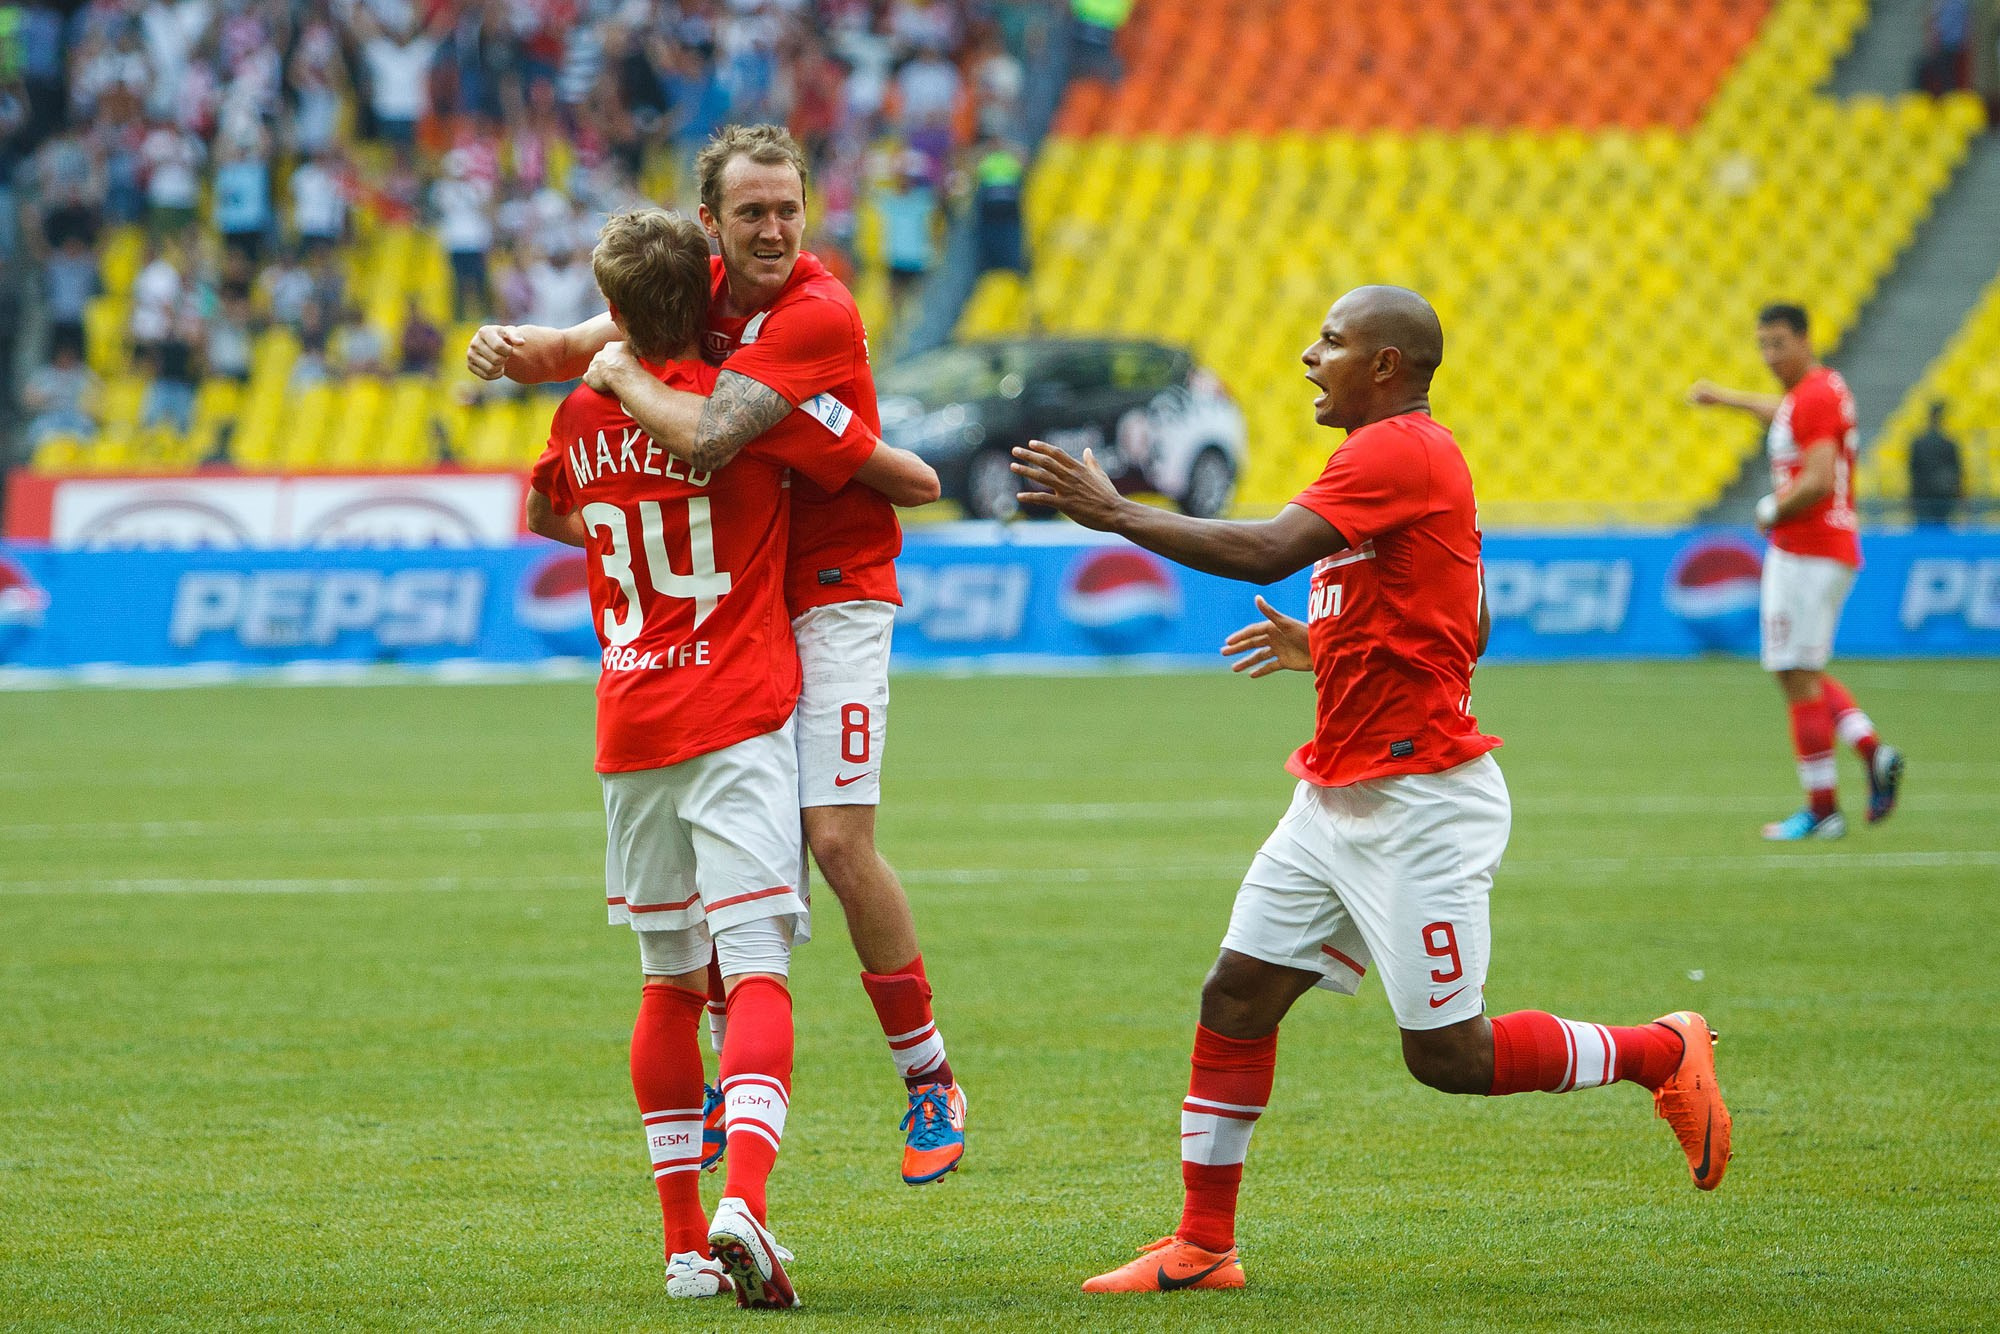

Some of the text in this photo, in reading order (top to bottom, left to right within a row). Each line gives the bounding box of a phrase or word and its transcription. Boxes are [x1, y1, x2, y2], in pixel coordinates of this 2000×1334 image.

[582, 496, 732, 646] 34
[169, 570, 484, 647] PEPSI
[841, 703, 870, 764] 8
[1421, 921, 1463, 983] 9
[653, 1133, 689, 1148] FCSM
